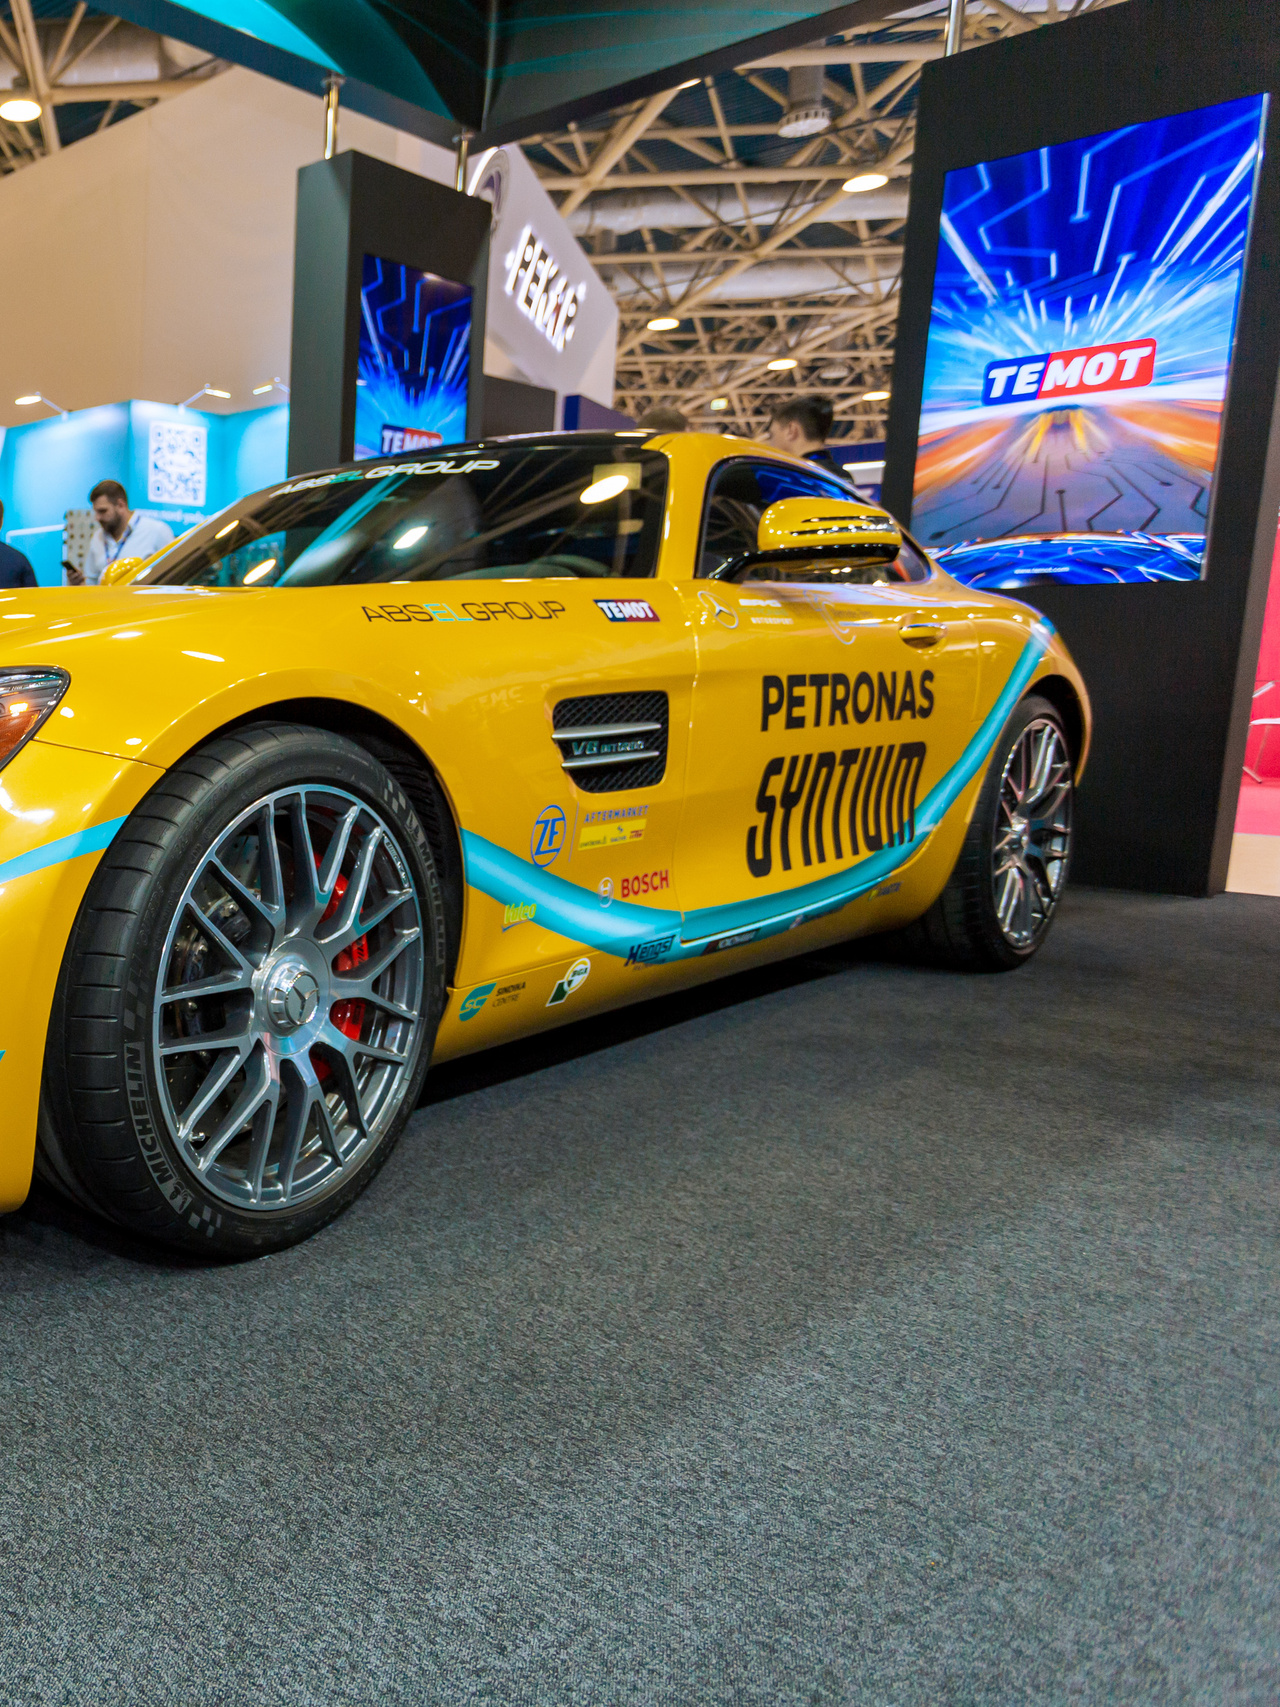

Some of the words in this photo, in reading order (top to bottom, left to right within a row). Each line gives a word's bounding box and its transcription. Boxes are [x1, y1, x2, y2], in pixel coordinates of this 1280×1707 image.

[987, 345, 1153, 398] TEMOT
[269, 459, 500, 498] ABSELGROUP
[361, 600, 565, 622] ABSELGROUP
[597, 601, 654, 619] TEMOT
[760, 669, 935, 732] PETRONAS
[583, 805, 649, 823] AFTERMARKET
[746, 741, 927, 878] SYNTIUM
[534, 817, 565, 856] ZF
[420, 841, 445, 962] MICHELIN
[621, 869, 670, 899] BOSCH
[504, 902, 537, 924] Valeo
[125, 1045, 175, 1186] MICHELIN
